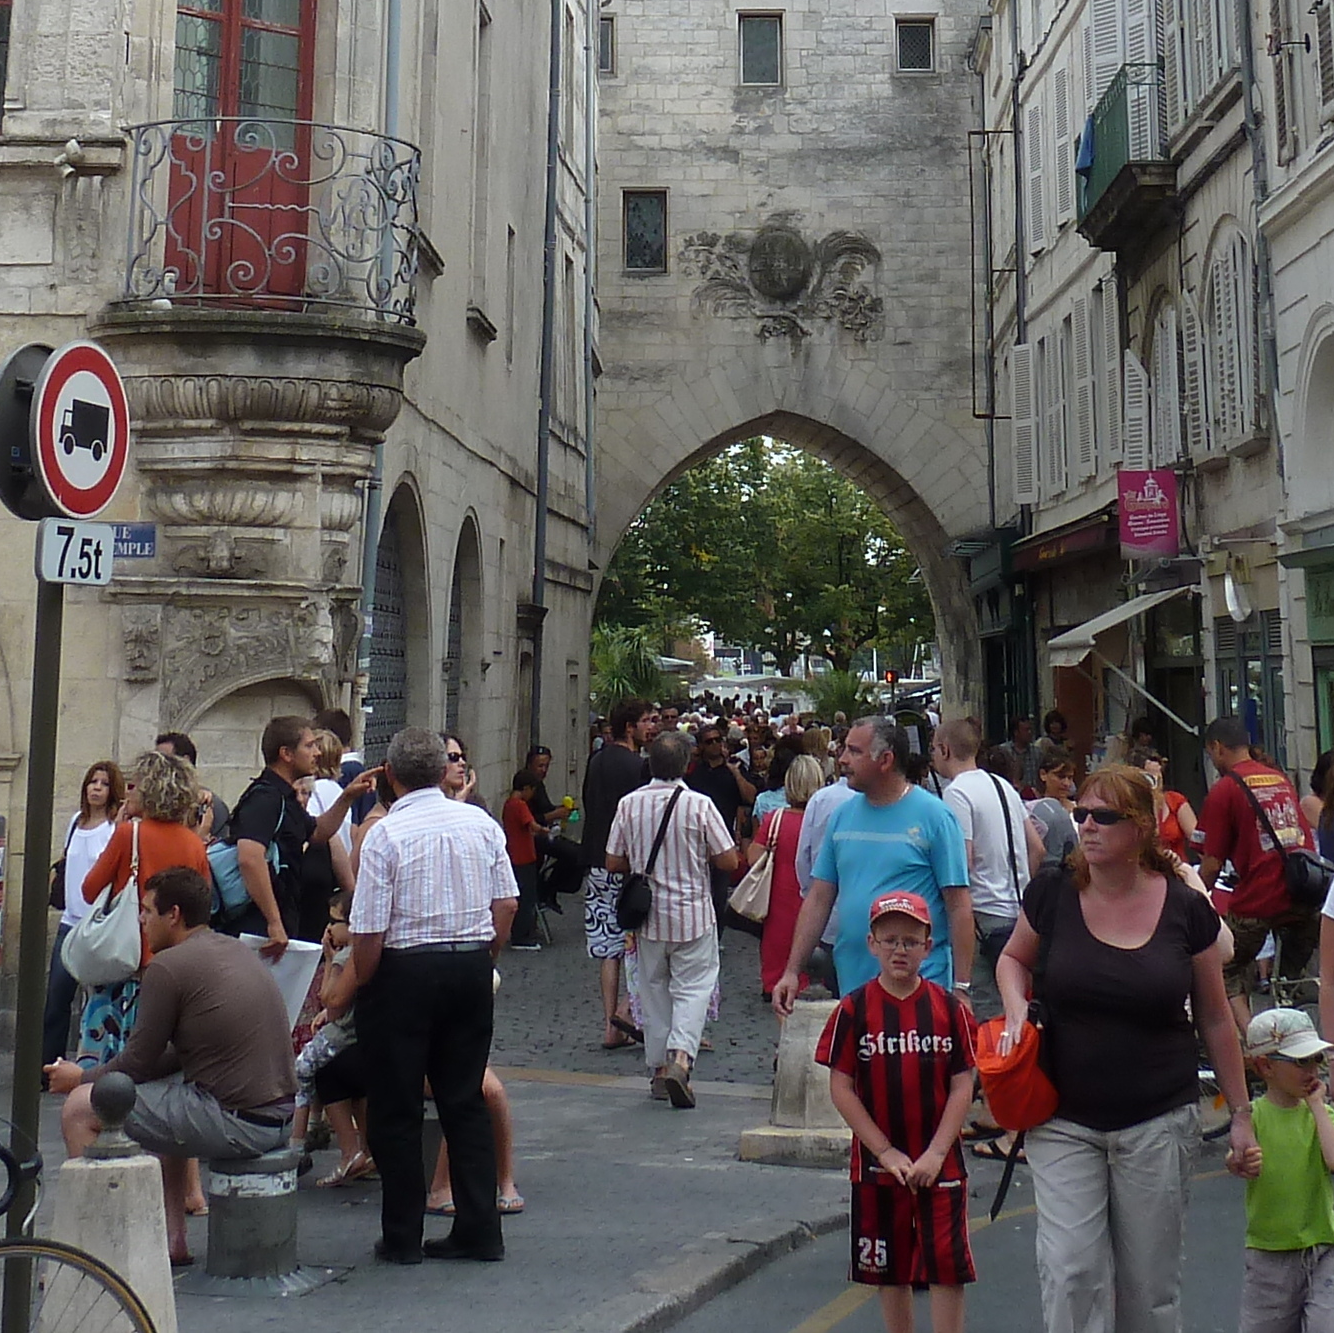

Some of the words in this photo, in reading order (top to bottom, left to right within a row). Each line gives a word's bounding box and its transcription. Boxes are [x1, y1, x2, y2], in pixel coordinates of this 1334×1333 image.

[112, 527, 132, 539] UE
[56, 526, 103, 580] 7.5t
[857, 1029, 953, 1062] Strikers
[857, 1237, 887, 1267] 25
